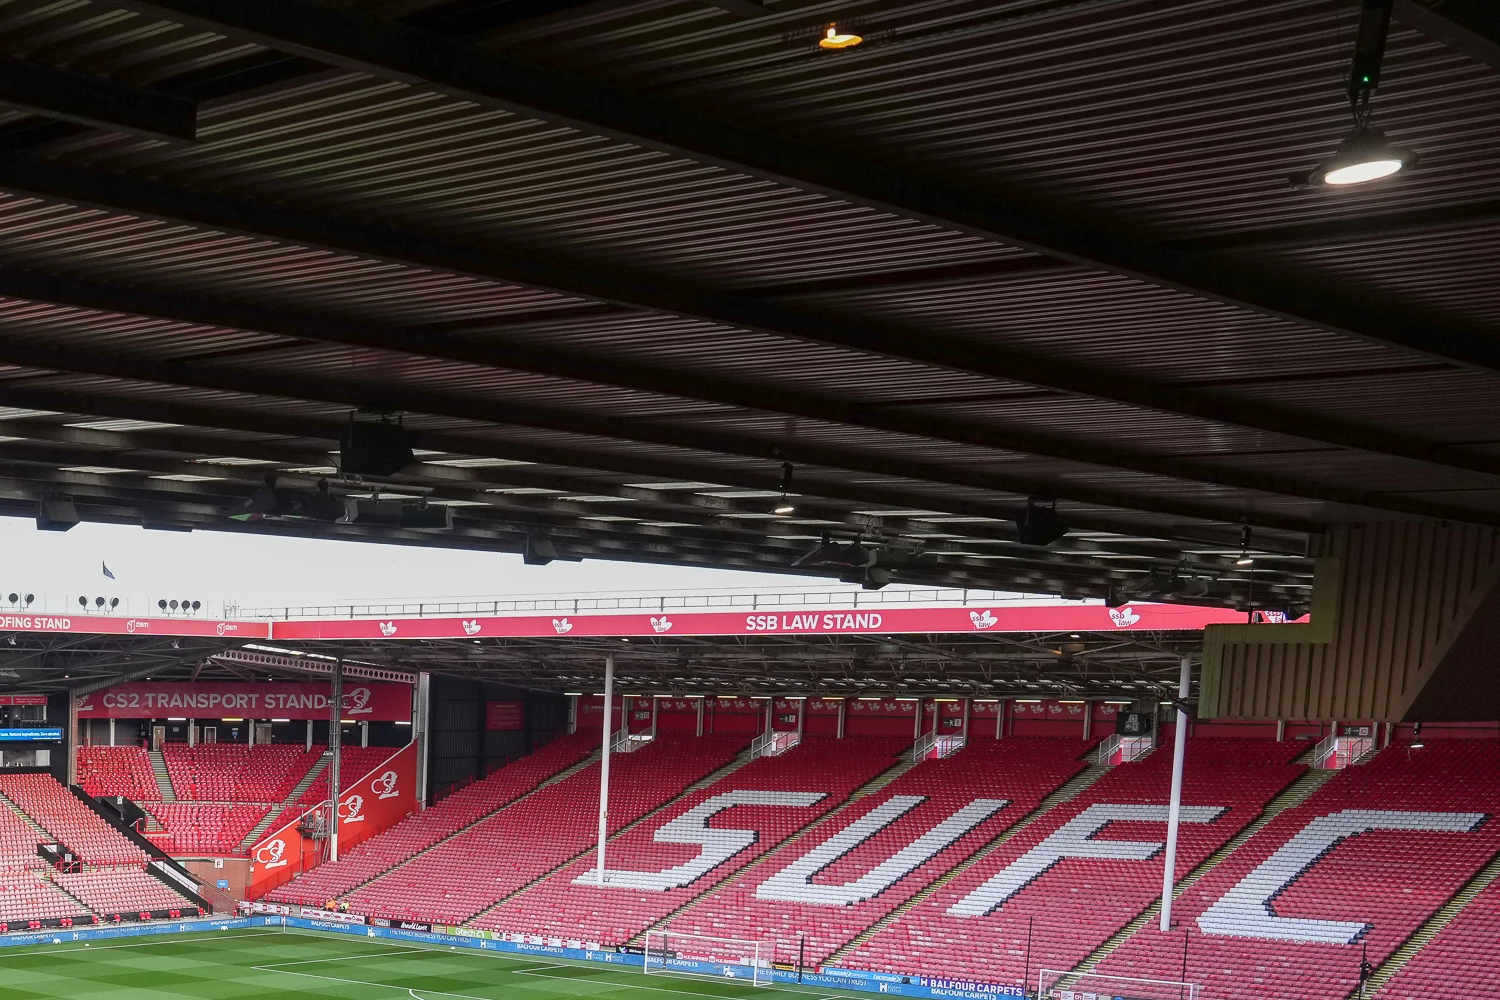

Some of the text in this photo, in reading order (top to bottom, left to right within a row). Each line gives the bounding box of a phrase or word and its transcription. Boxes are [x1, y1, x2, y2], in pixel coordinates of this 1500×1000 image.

[34, 618, 70, 630] STAND
[745, 614, 882, 630] SSB LAW STAND
[1111, 612, 1125, 620] ssb
[103, 693, 328, 709] CS2 TRANSPORT STAND
[570, 788, 1492, 944] SUFC
[455, 927, 475, 937] Gtech
[931, 979, 1022, 996] BALFOUR CARPETS
